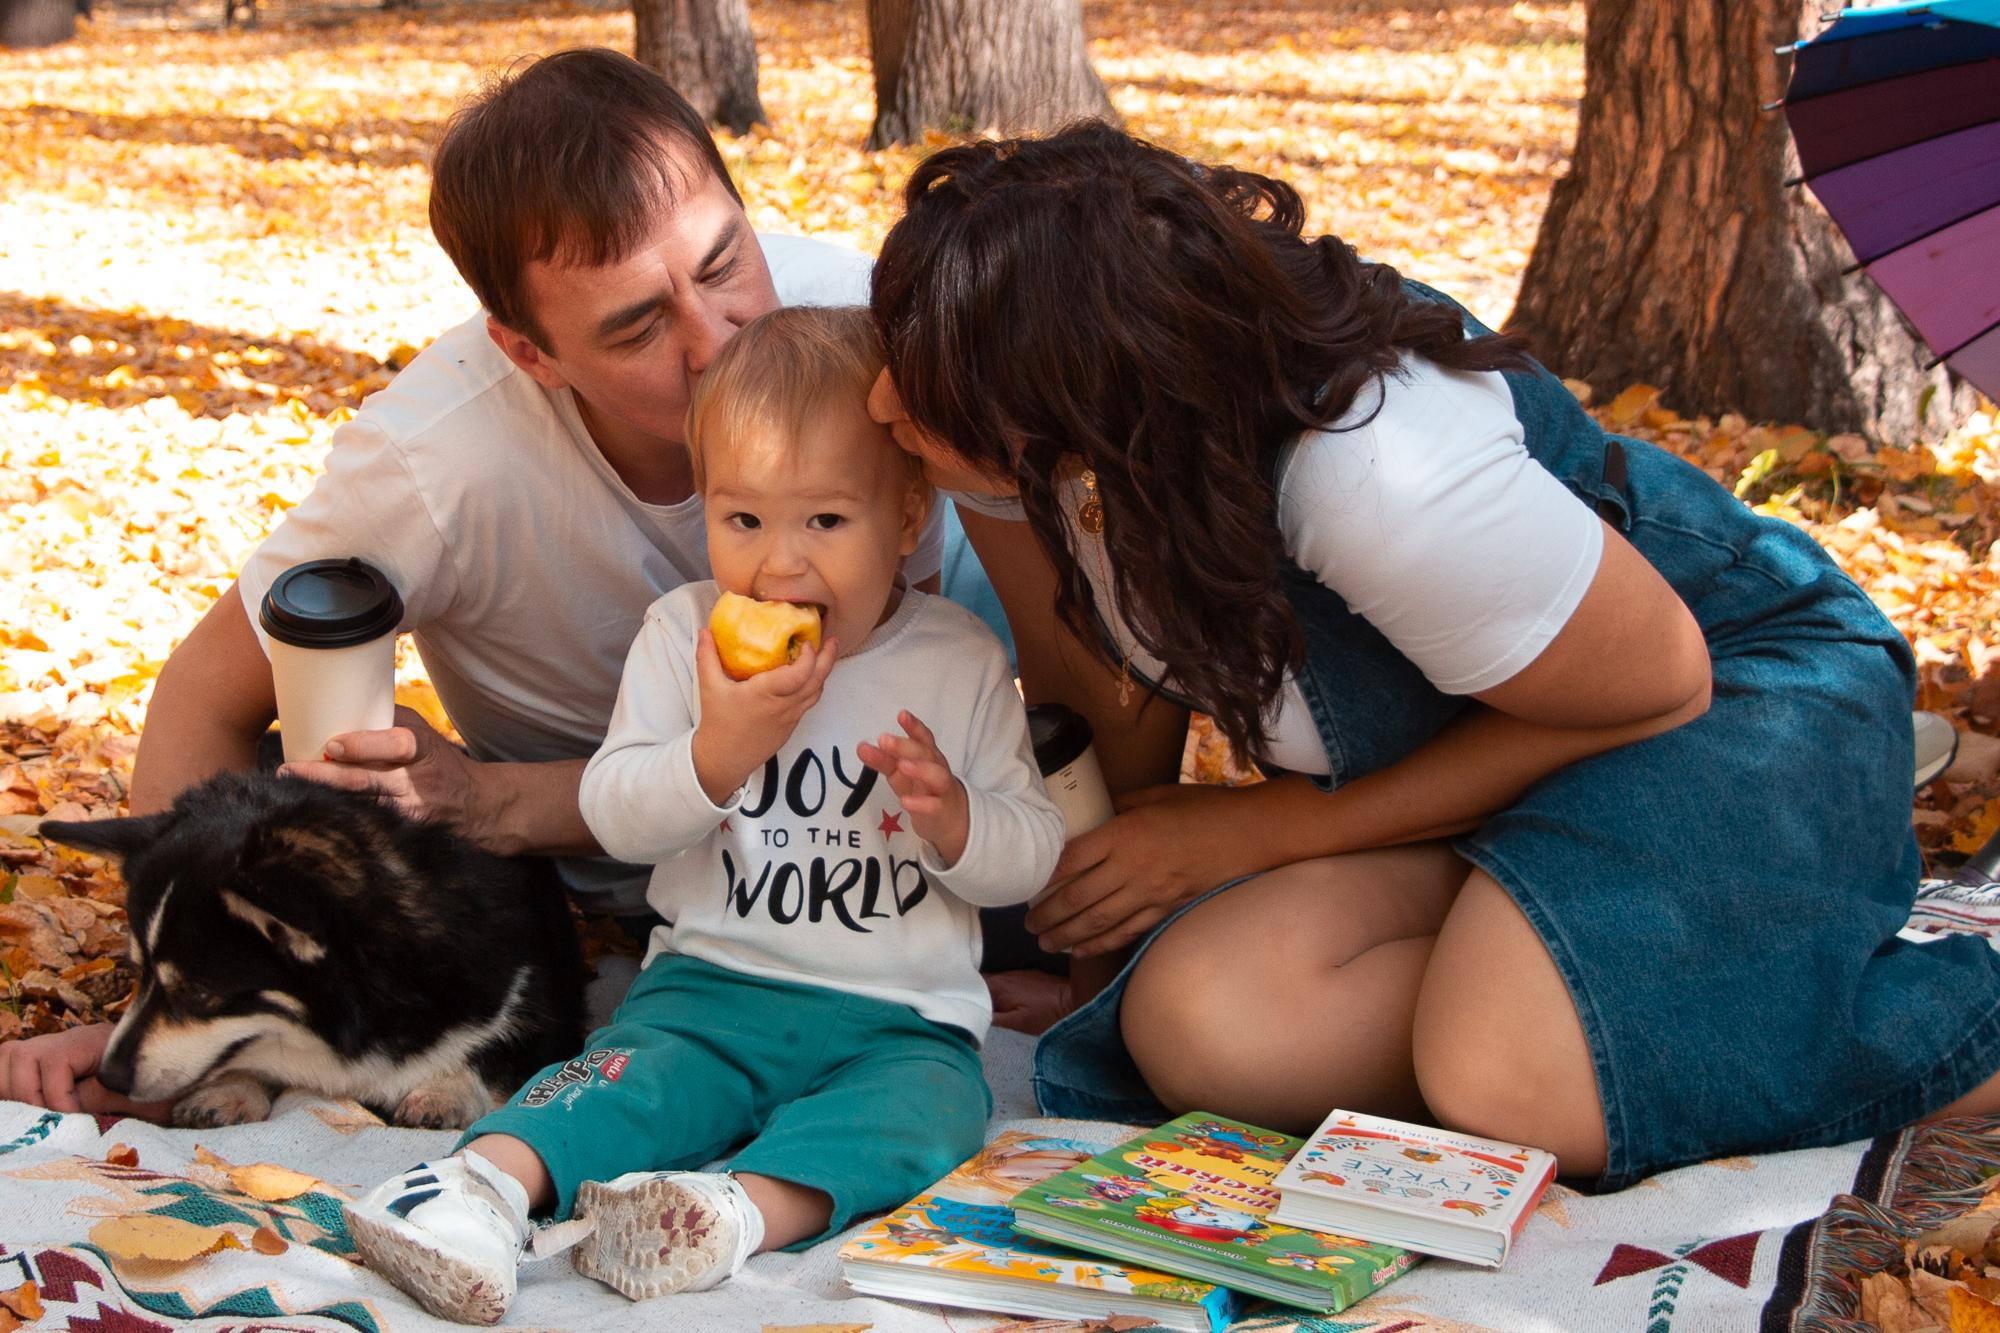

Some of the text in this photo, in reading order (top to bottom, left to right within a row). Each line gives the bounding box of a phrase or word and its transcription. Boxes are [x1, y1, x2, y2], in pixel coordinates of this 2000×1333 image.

[739, 745, 879, 818] JOY
[760, 827, 861, 848] TO THE
[721, 849, 928, 933] WORLD
[606, 1055, 626, 1079] mini
[561, 1086, 584, 1111] junior
[1342, 1158, 1472, 1192] LYKKE
